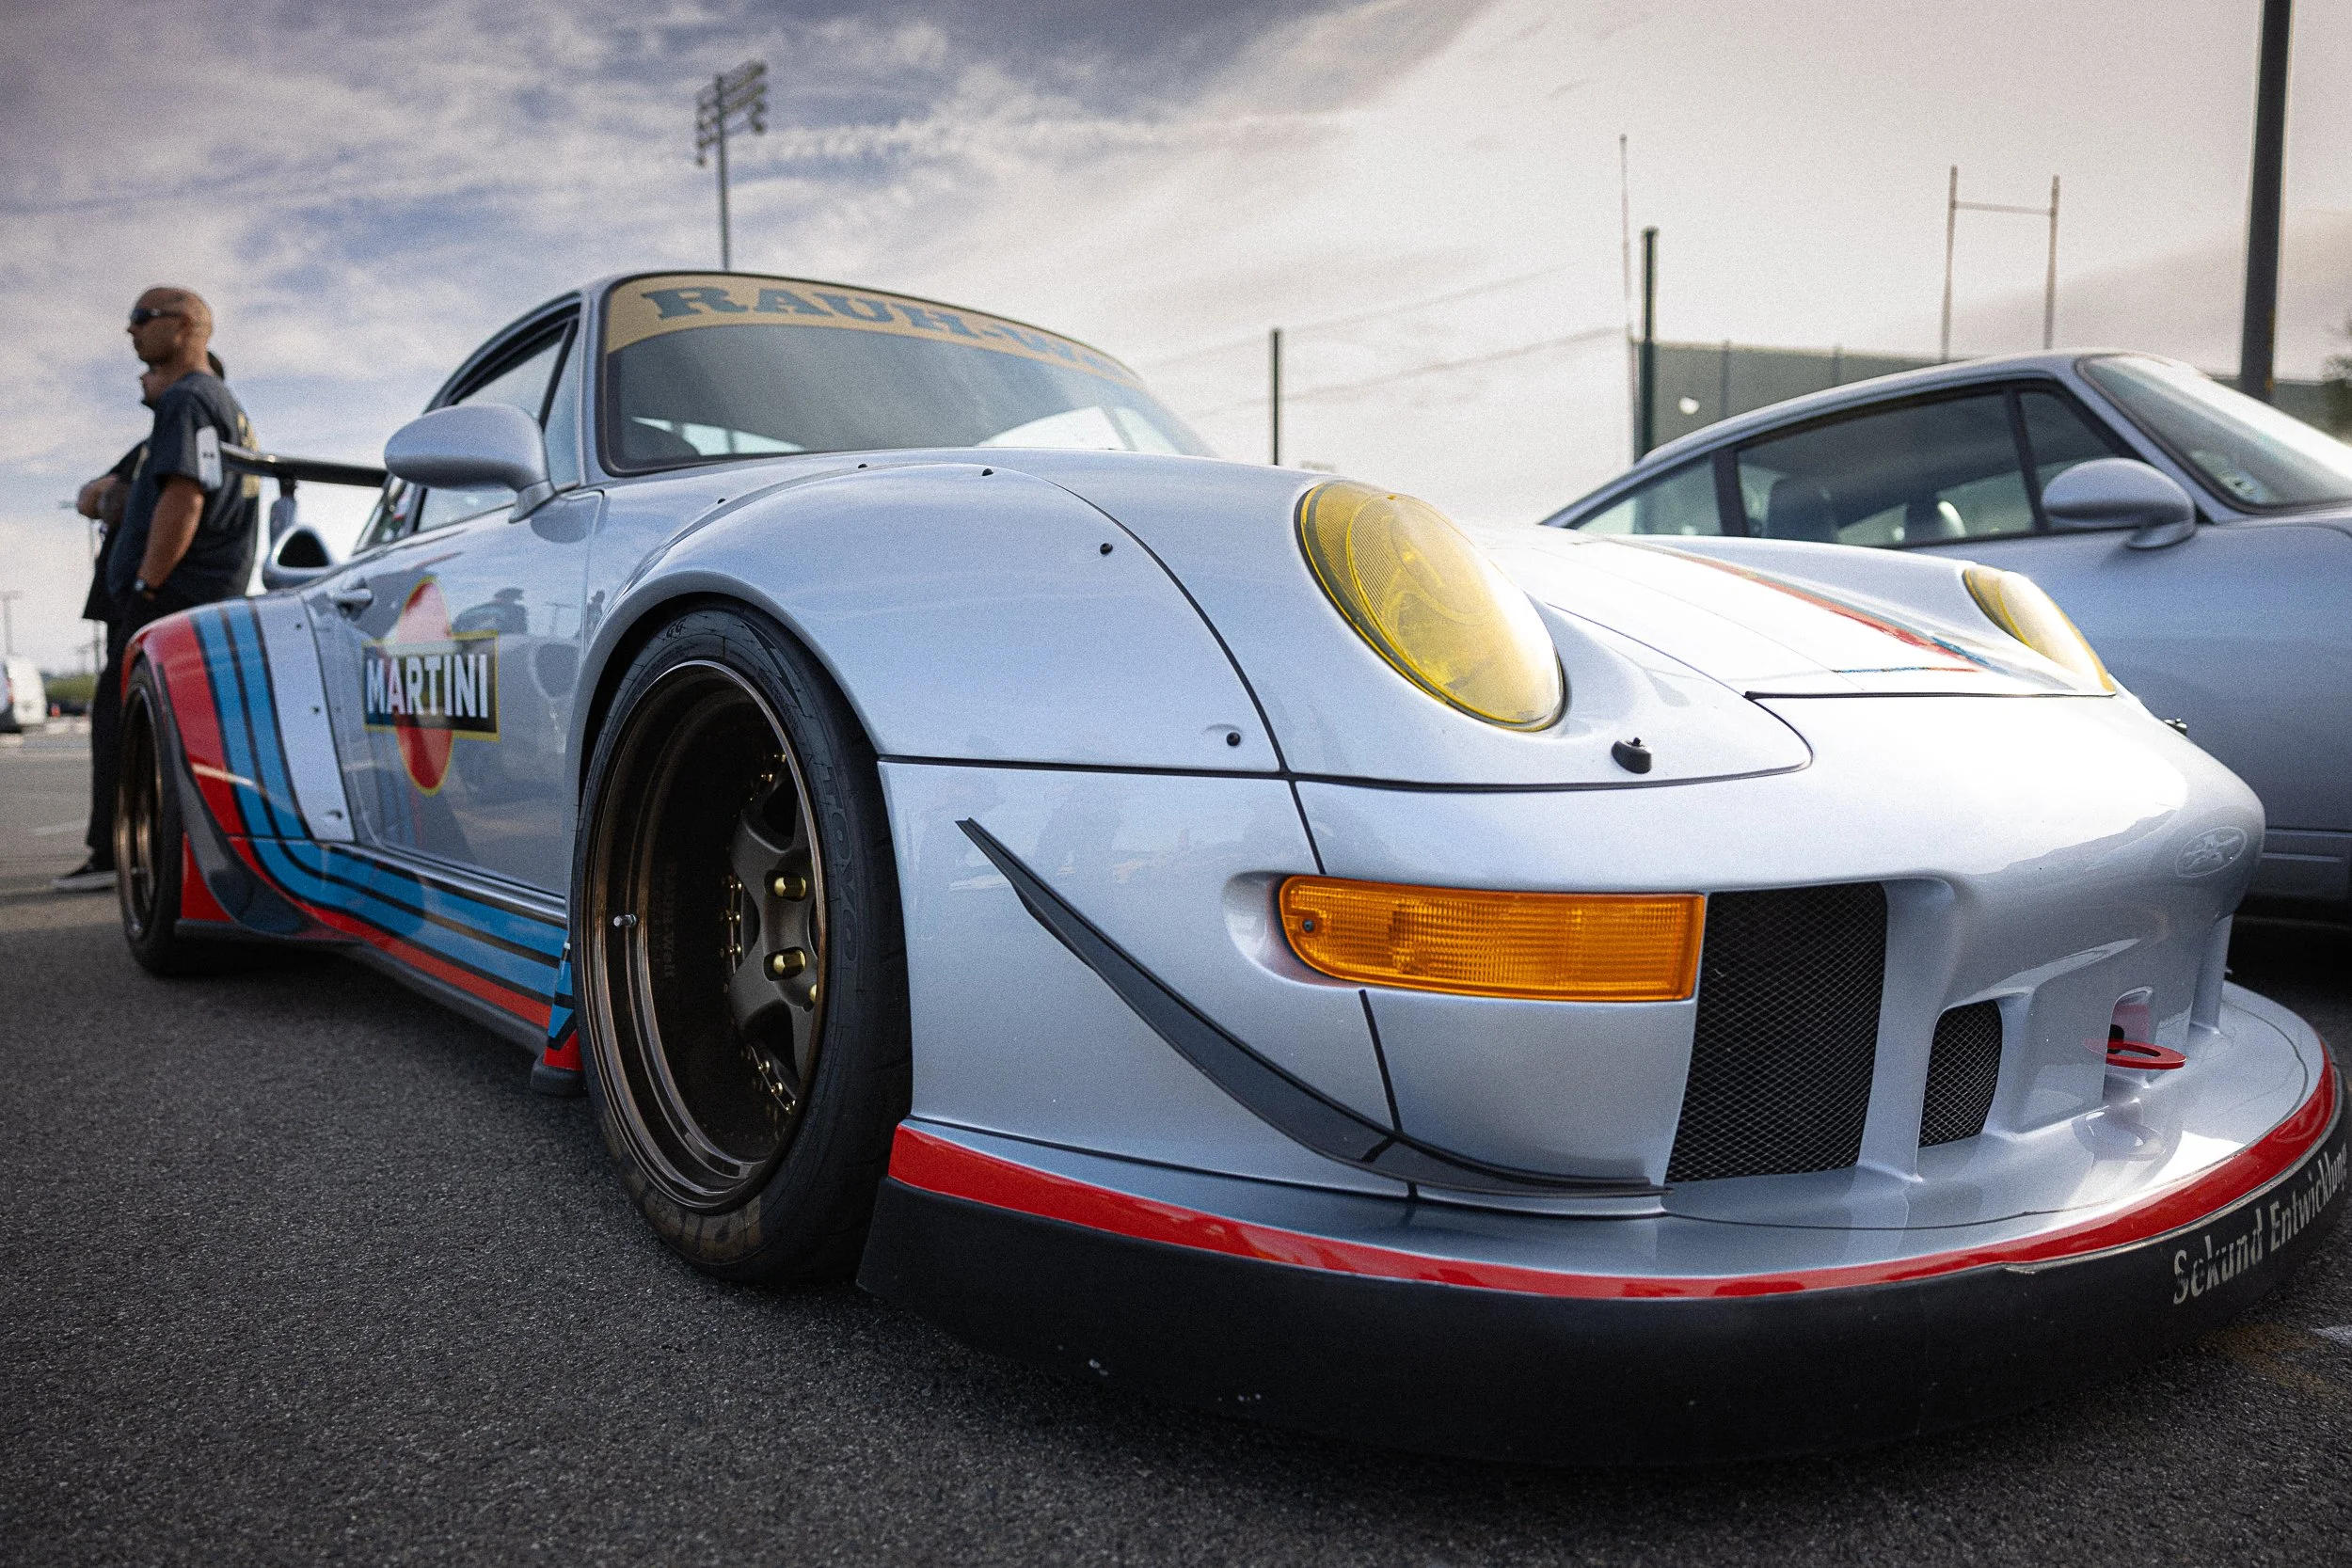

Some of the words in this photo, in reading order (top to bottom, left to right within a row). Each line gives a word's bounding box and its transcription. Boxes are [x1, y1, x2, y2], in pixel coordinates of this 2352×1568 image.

[367, 654, 488, 719] MARTINI
[823, 766, 858, 962] TOYO
[2269, 1142, 2348, 1253] Entwicklung
